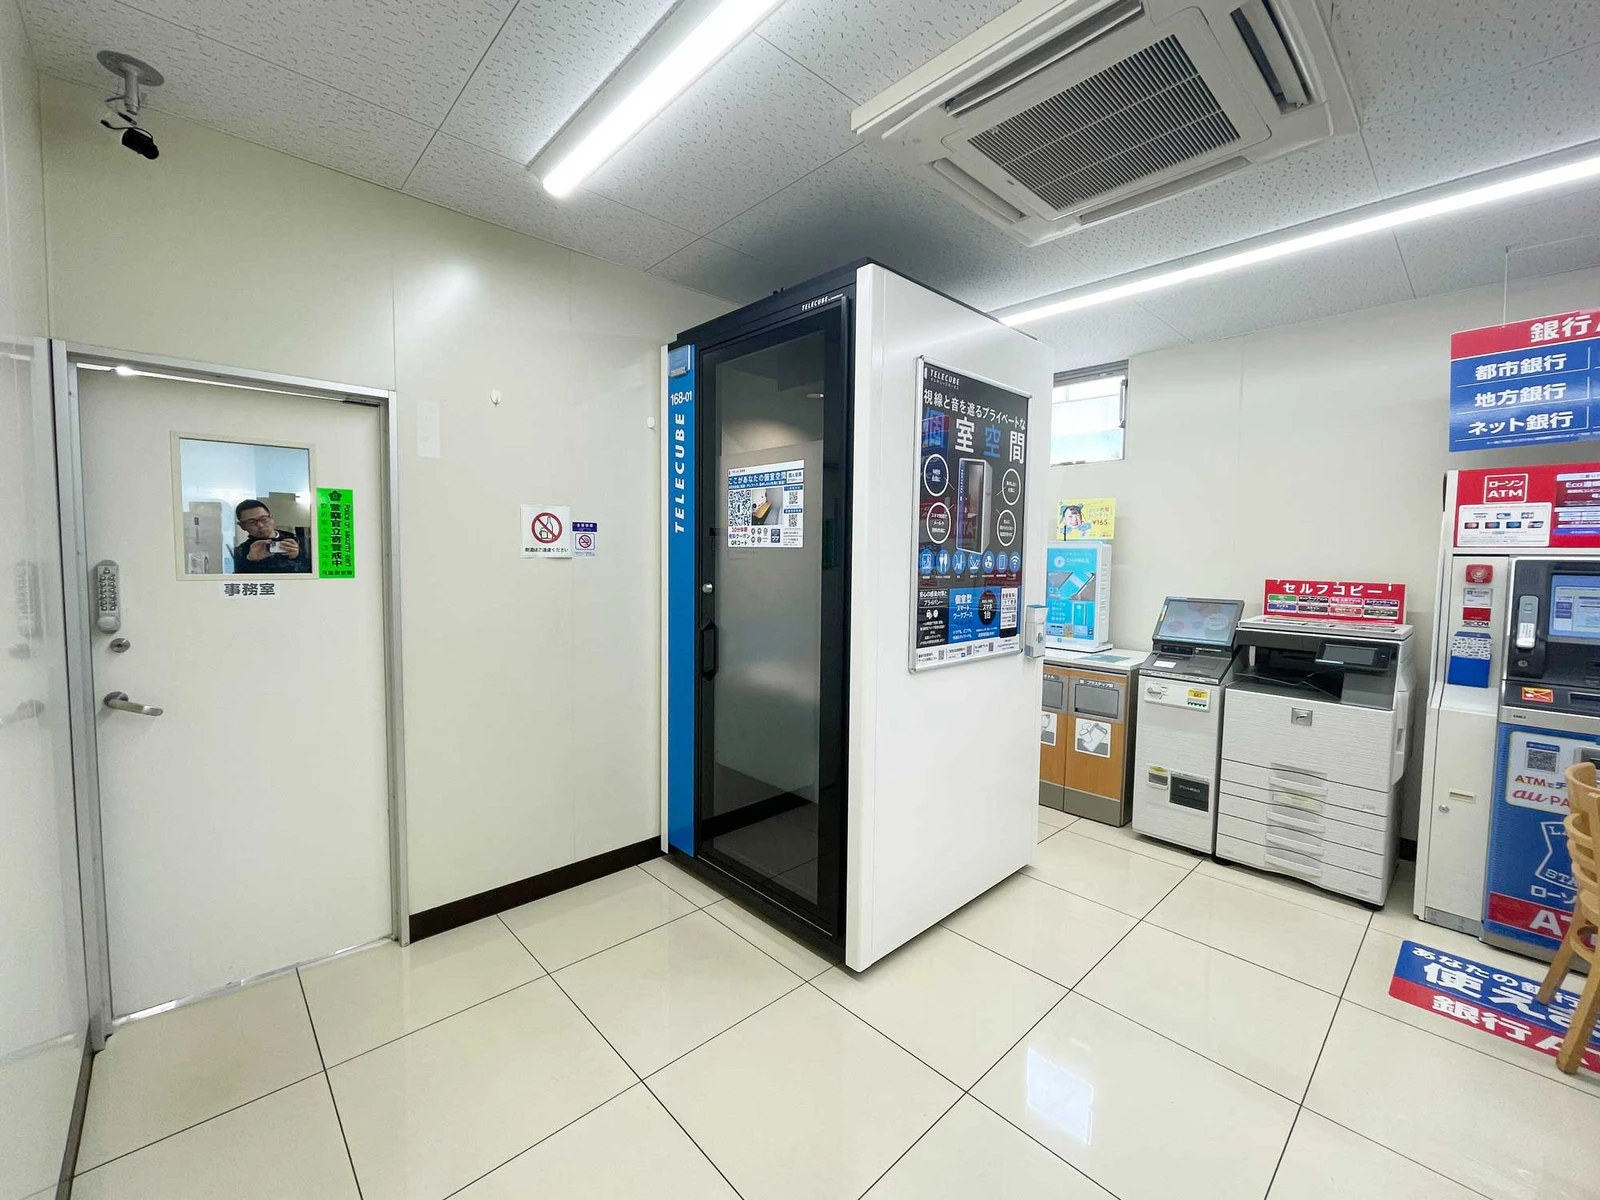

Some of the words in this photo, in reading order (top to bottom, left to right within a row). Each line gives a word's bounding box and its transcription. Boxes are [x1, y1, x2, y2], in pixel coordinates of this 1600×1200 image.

[1475, 353, 1567, 380] 都市銀行
[930, 369, 960, 386] TELECUBE
[670, 390, 693, 406] 168-01
[1474, 382, 1567, 408] 地方銀行
[923, 388, 1026, 431] 視線と音を遮るプライベートな
[1468, 411, 1574, 436] ネット銀行
[675, 413, 685, 534] TELECUBE
[1489, 480, 1524, 488] ローソン
[1488, 489, 1523, 498] ATM
[224, 583, 275, 596] 事務室
[1283, 583, 1383, 596] セルフコピー
[954, 594, 973, 604] 個室型
[1512, 790, 1548, 803] au
